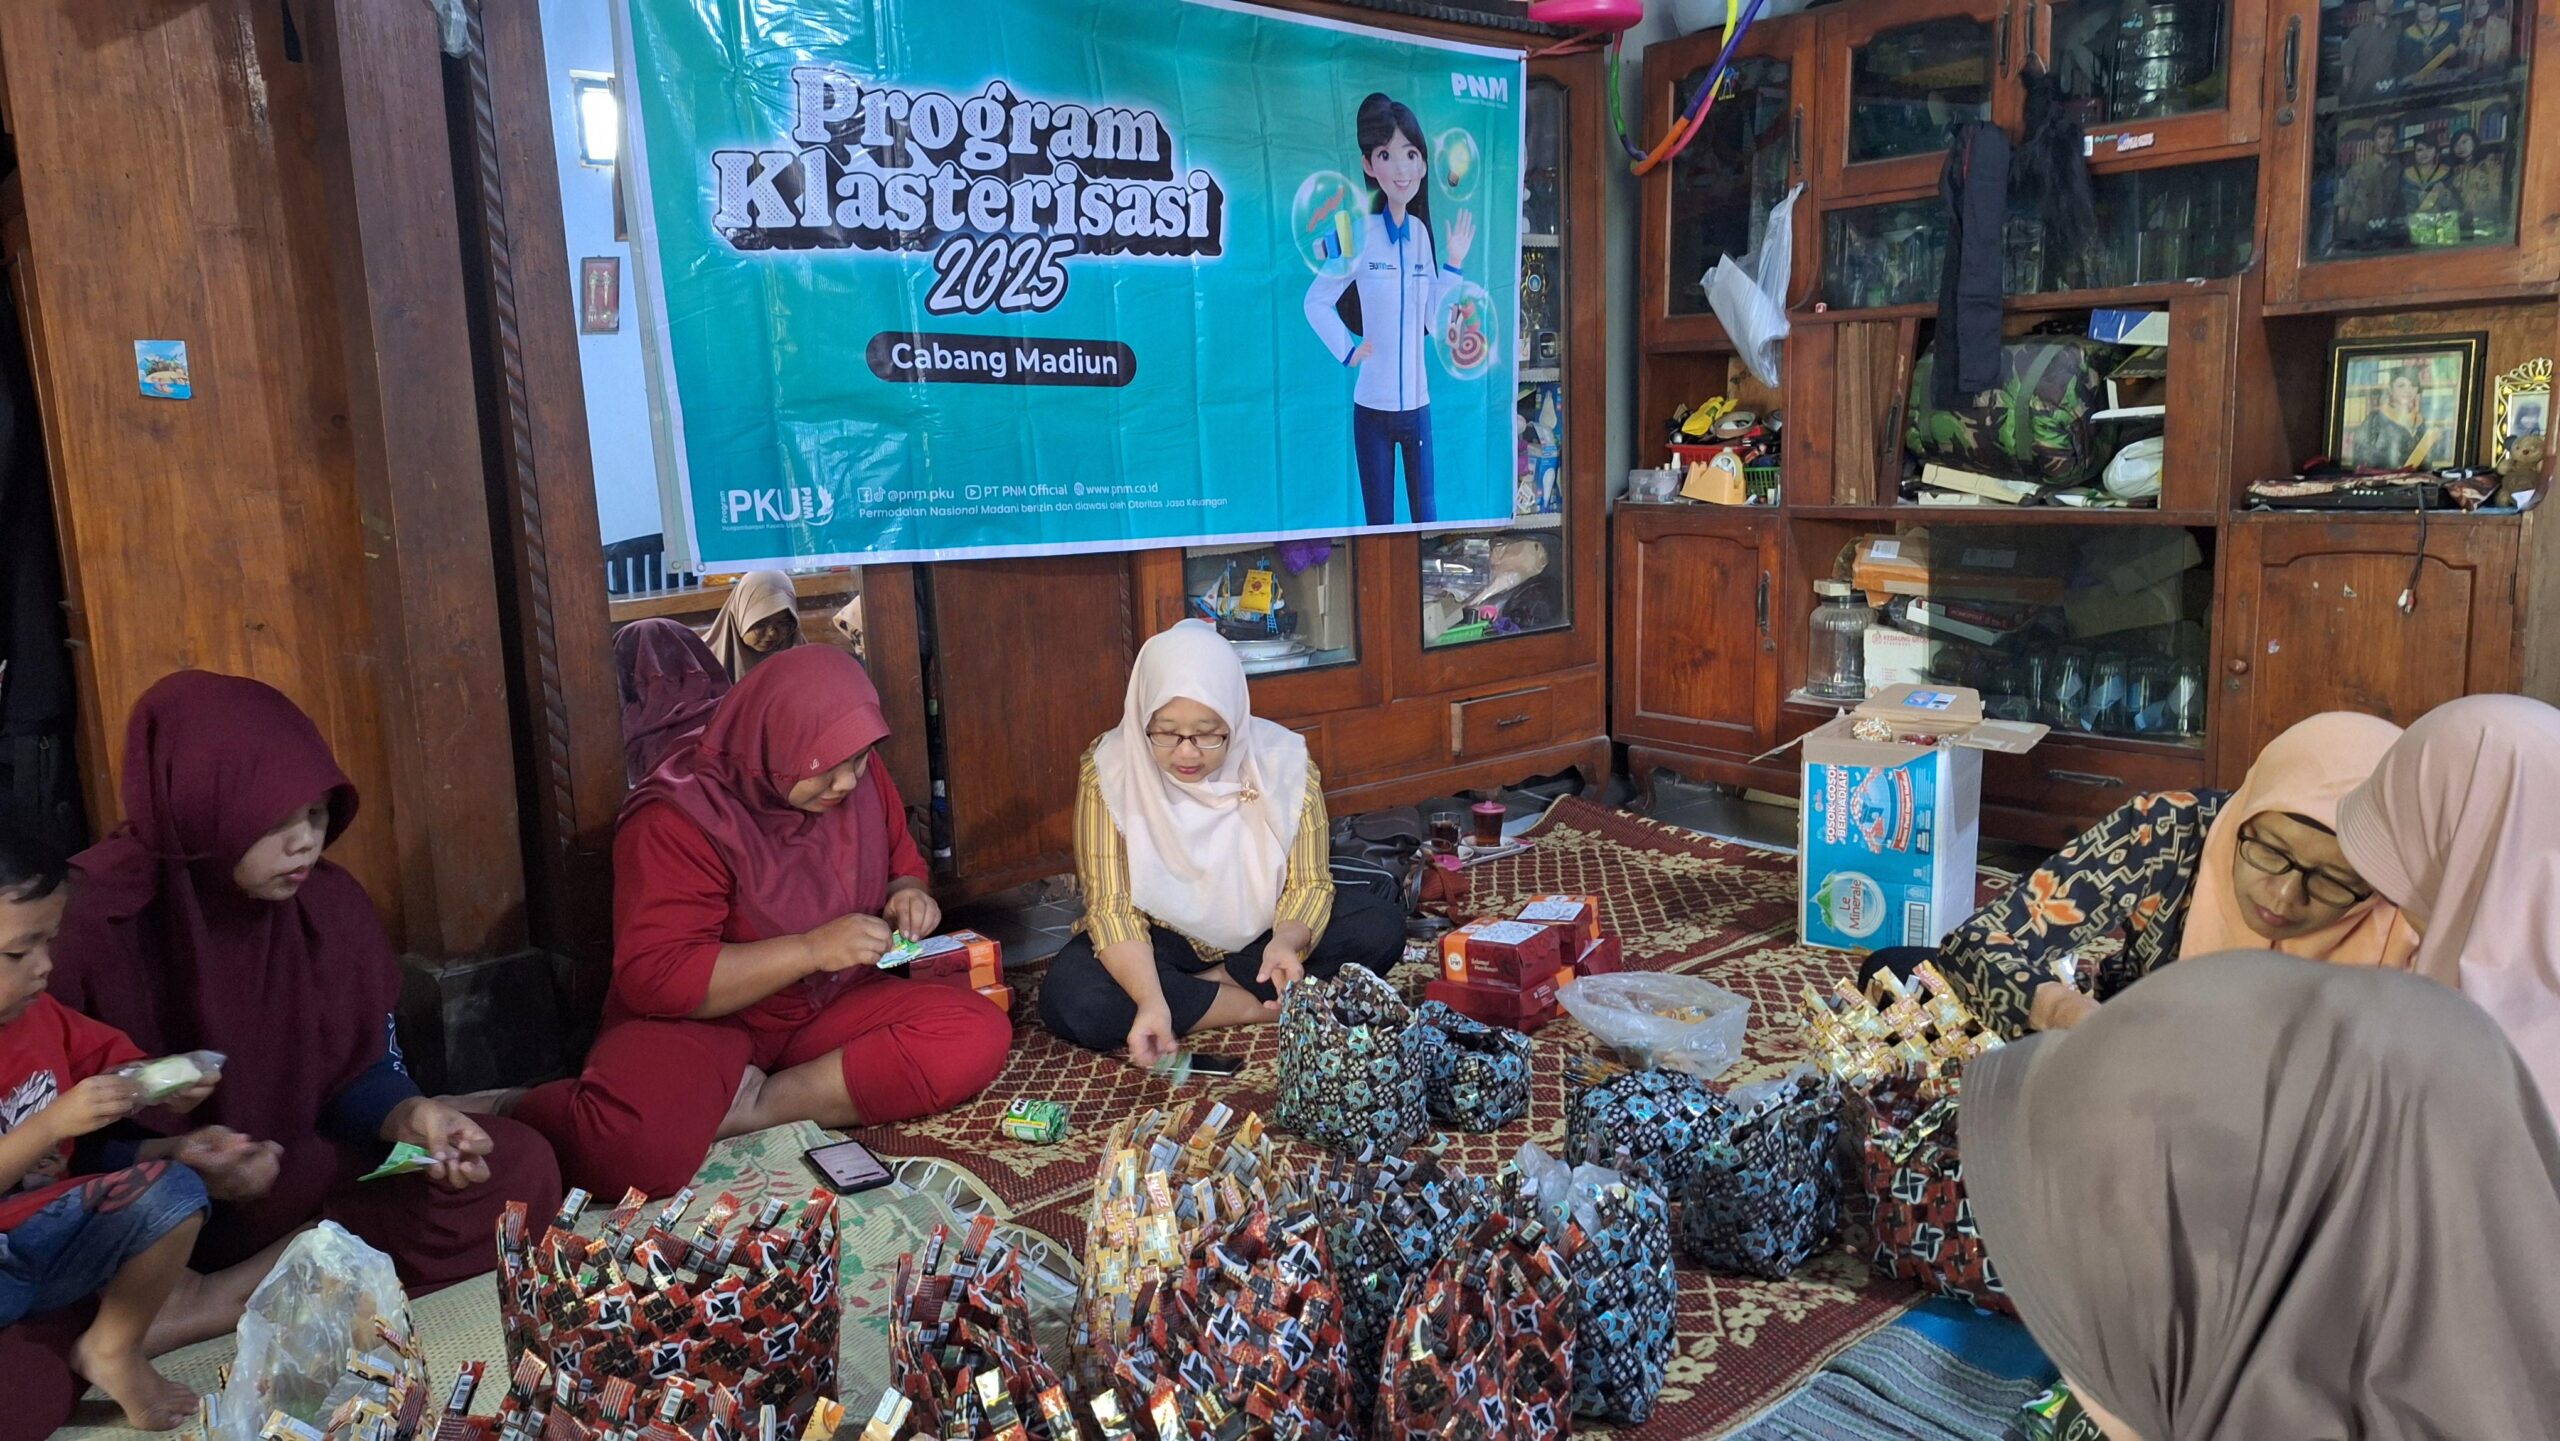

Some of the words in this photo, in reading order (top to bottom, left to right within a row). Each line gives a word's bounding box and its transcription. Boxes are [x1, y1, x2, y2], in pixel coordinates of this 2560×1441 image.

[1451, 72, 1509, 103] PNM
[792, 66, 1166, 176] Program
[712, 147, 1218, 248] Klasterisasi
[927, 235, 1073, 313] 2025
[891, 343, 1006, 378] Cabang
[1015, 348, 1118, 375] Madiun
[719, 490, 728, 523] Program
[728, 488, 800, 523] PKU
[800, 487, 814, 518] PNM
[859, 506, 927, 519] Permodalan
[930, 505, 978, 516] Nasional
[981, 503, 1019, 515] Madani
[1021, 503, 1053, 513] berizin
[1055, 502, 1073, 512] dan
[1075, 501, 1108, 511] diawasi
[1128, 499, 1163, 509] Otoritas
[1186, 497, 1228, 509] Keuangan
[984, 486, 999, 497] PT
[1002, 485, 1026, 497] PNM
[1029, 484, 1068, 496] Official
[1837, 770, 1848, 838] BERHADIAH
[1840, 896, 1851, 911] Le
[1849, 879, 1862, 930] Minerale
